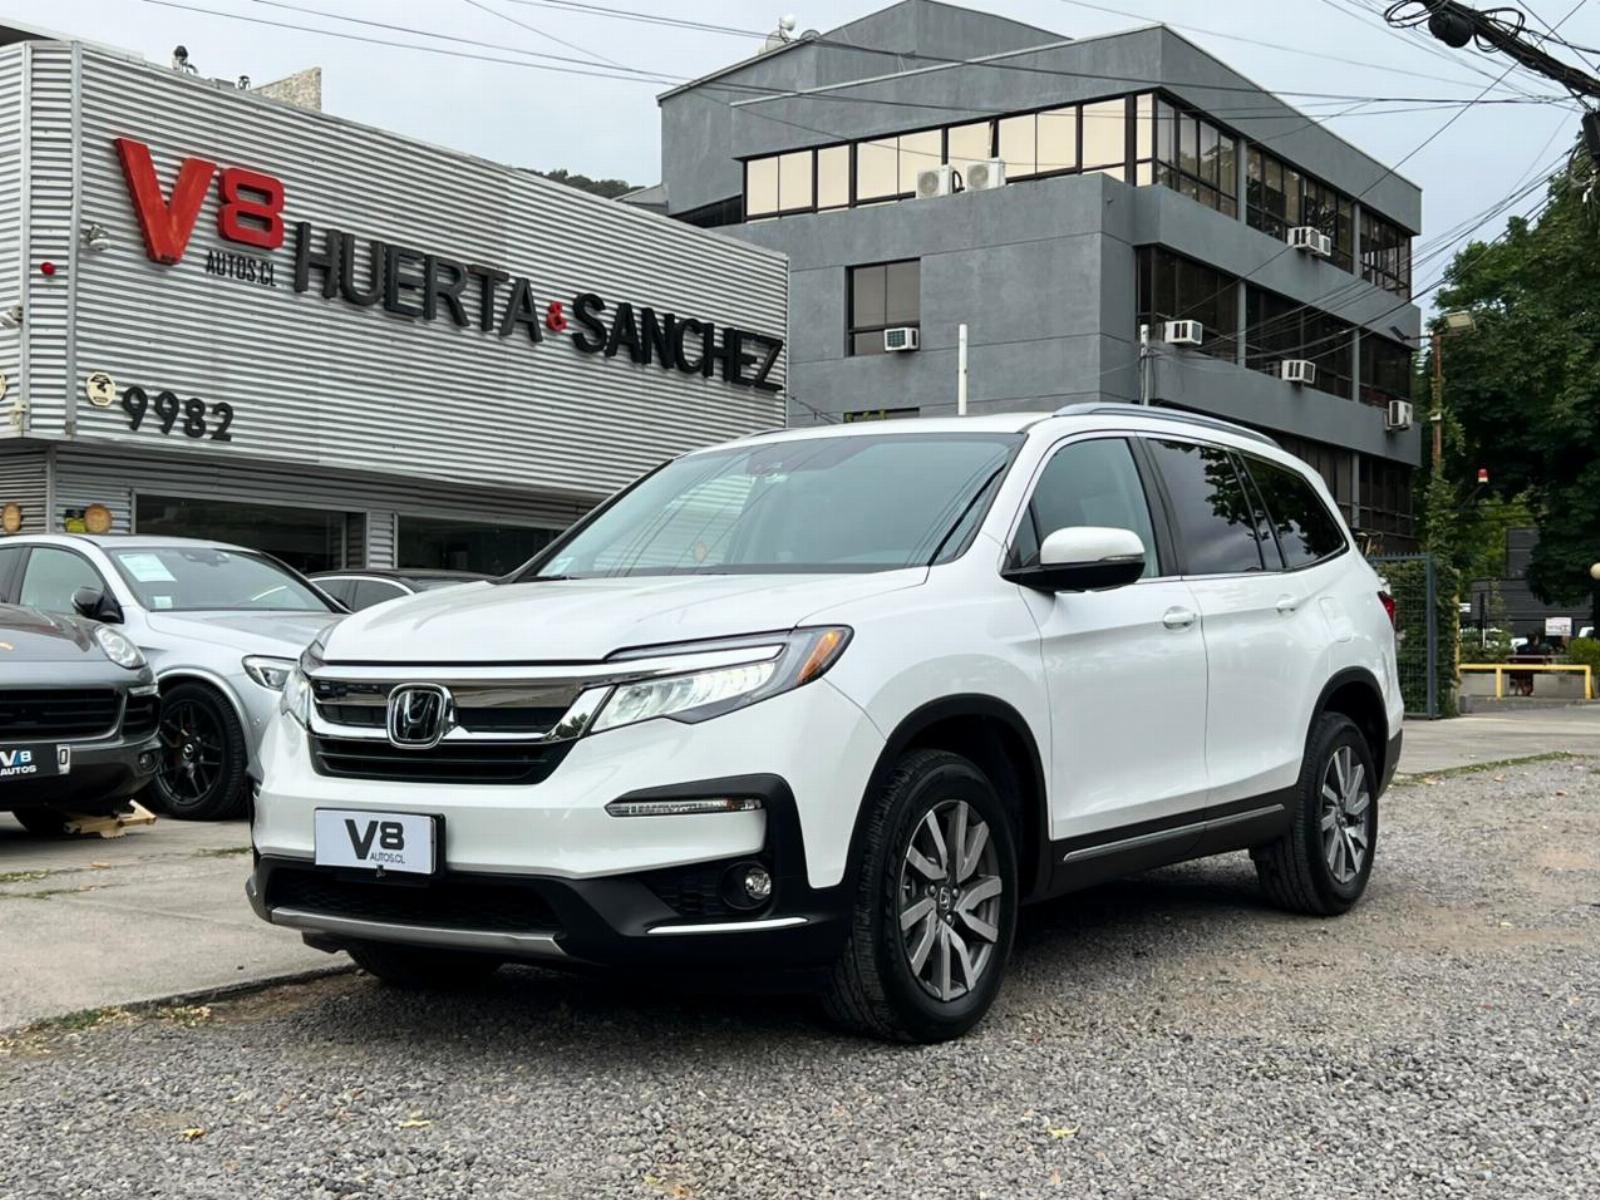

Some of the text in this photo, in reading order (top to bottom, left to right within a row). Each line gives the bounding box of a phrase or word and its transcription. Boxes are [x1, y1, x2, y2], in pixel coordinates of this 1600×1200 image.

[115, 137, 285, 265] V8
[206, 250, 277, 287] AUTOS.CL
[294, 221, 784, 391] HUERTA & SANCHEZ
[121, 386, 234, 442] 9982
[0, 764, 37, 776] AUTOS
[344, 818, 405, 860] V8
